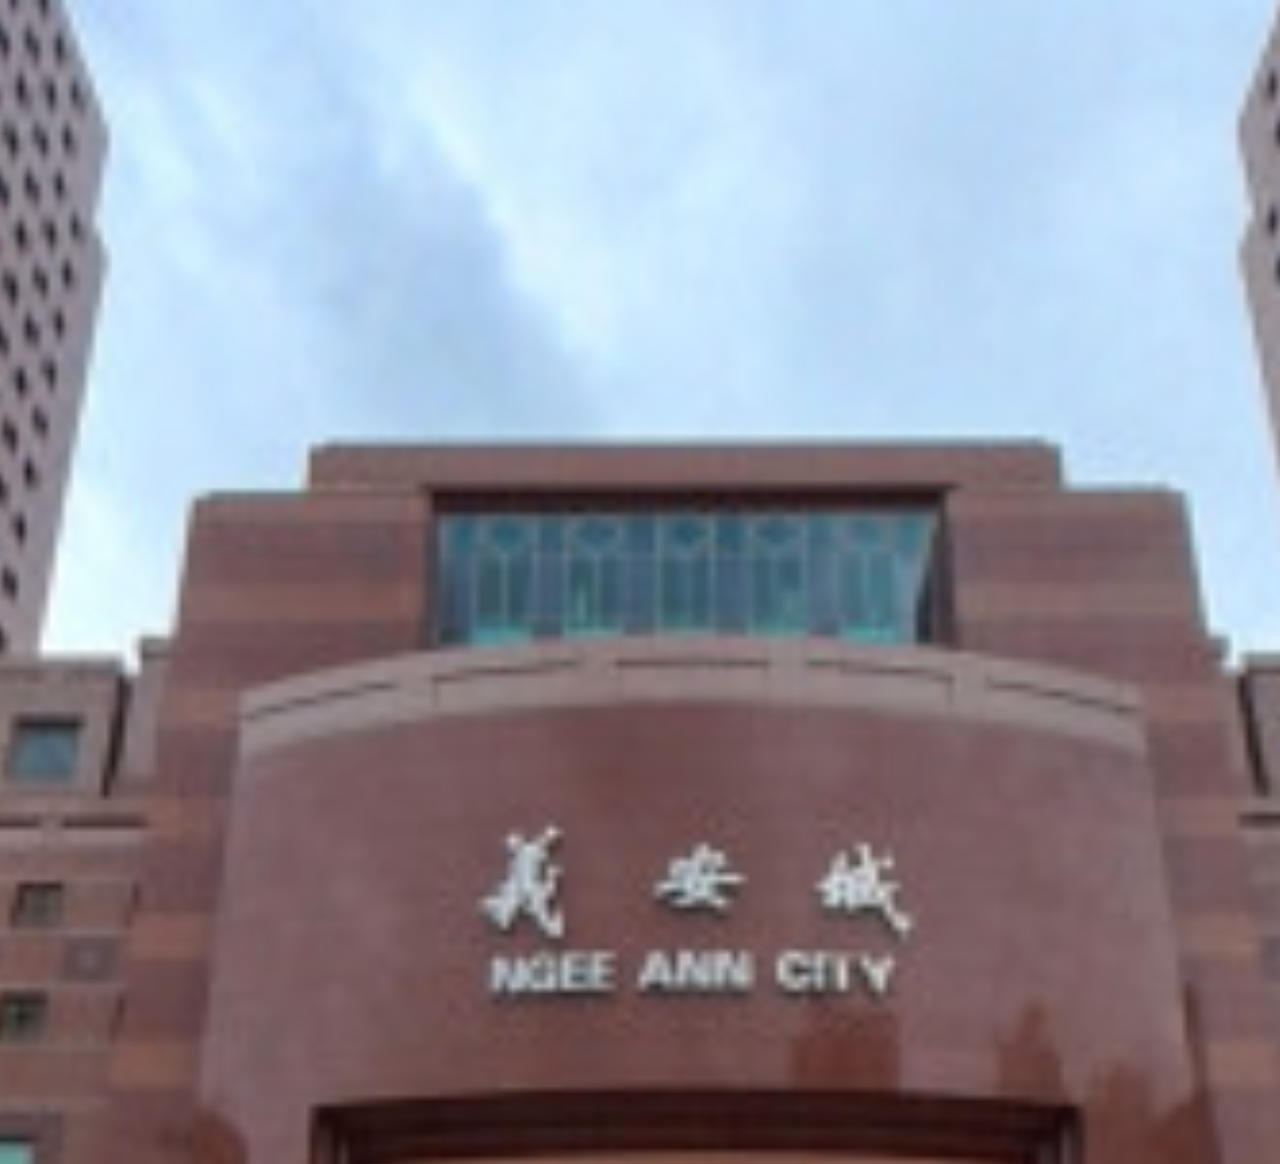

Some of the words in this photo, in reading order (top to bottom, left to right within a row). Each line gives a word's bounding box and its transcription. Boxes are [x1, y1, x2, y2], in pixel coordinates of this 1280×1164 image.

[490, 950, 615, 993] NGEE
[637, 950, 754, 992] ANN
[776, 950, 895, 992] CITY
